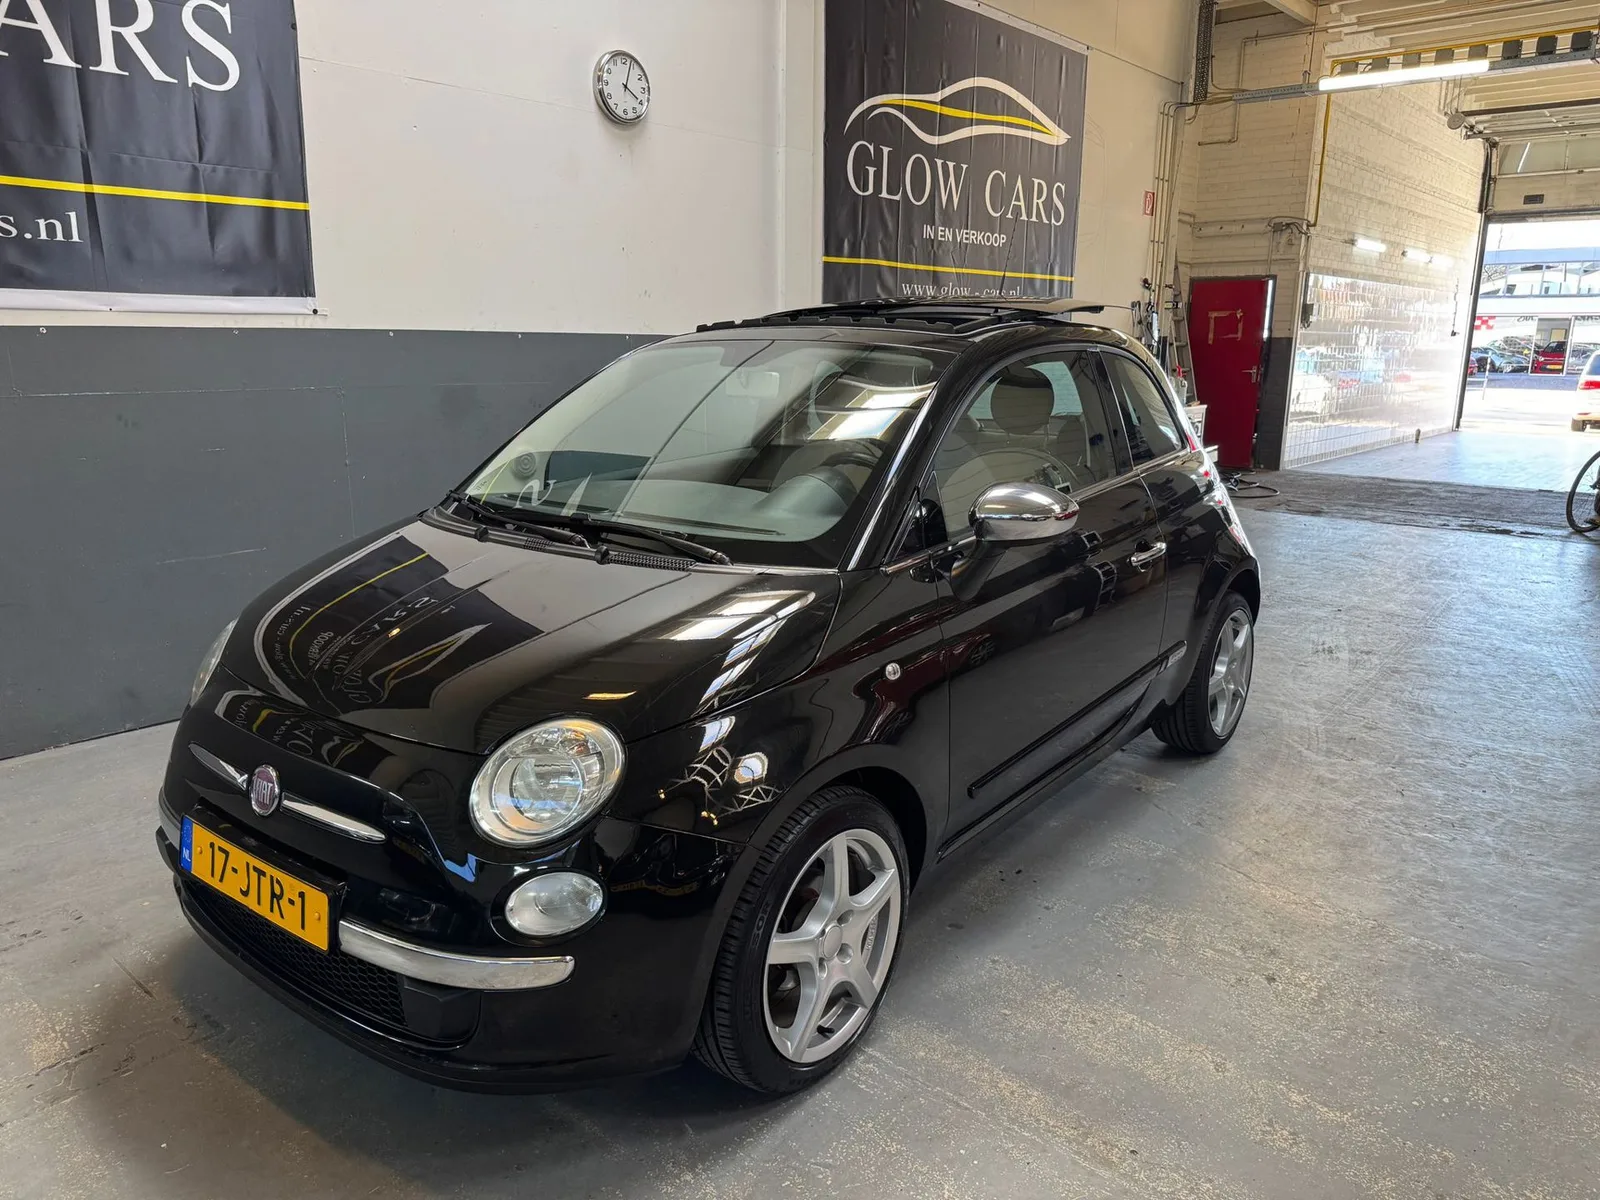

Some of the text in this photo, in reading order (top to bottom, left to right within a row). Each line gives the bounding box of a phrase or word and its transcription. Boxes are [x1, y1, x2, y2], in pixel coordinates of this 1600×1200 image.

[846, 140, 1066, 226] GLOW CARS
[0, 211, 84, 242] s.nl
[923, 224, 1007, 248] IN EN VERKOOP
[253, 776, 274, 805] FIAT
[182, 847, 191, 862] NL
[209, 841, 306, 931] 17-JTR-1
